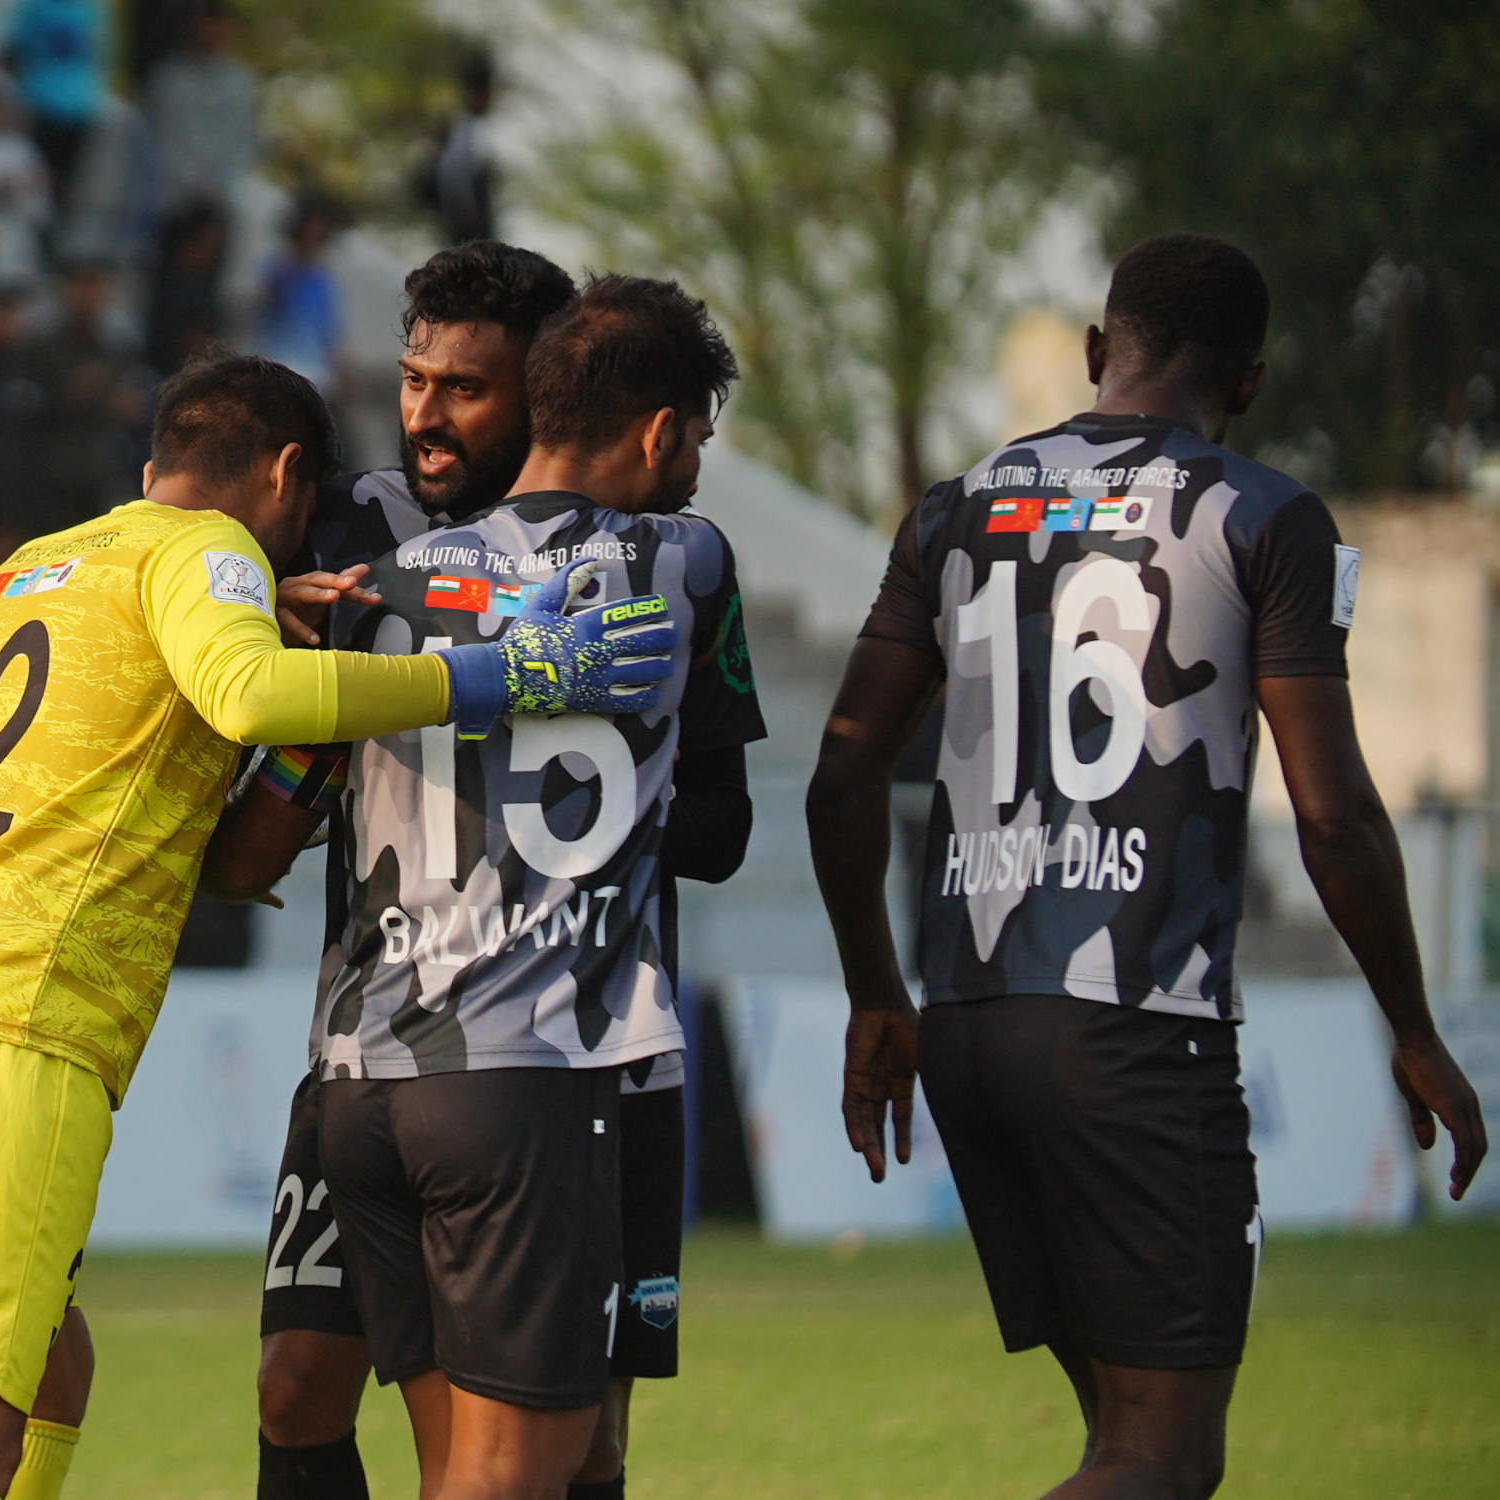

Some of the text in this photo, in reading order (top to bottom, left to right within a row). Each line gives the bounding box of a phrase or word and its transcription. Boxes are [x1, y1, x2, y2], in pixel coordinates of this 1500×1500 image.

[1039, 467, 1070, 488] THE
[1070, 467, 1126, 488] ARMED
[1125, 466, 1191, 490] FORCES
[405, 541, 638, 575] SALUTING THE ARMED FORCES
[958, 558, 1150, 805] 16
[422, 636, 637, 880] 15
[941, 823, 1147, 897] HUDSON DIAS
[378, 885, 623, 968] BALWANT
[265, 1173, 343, 1291] 22
